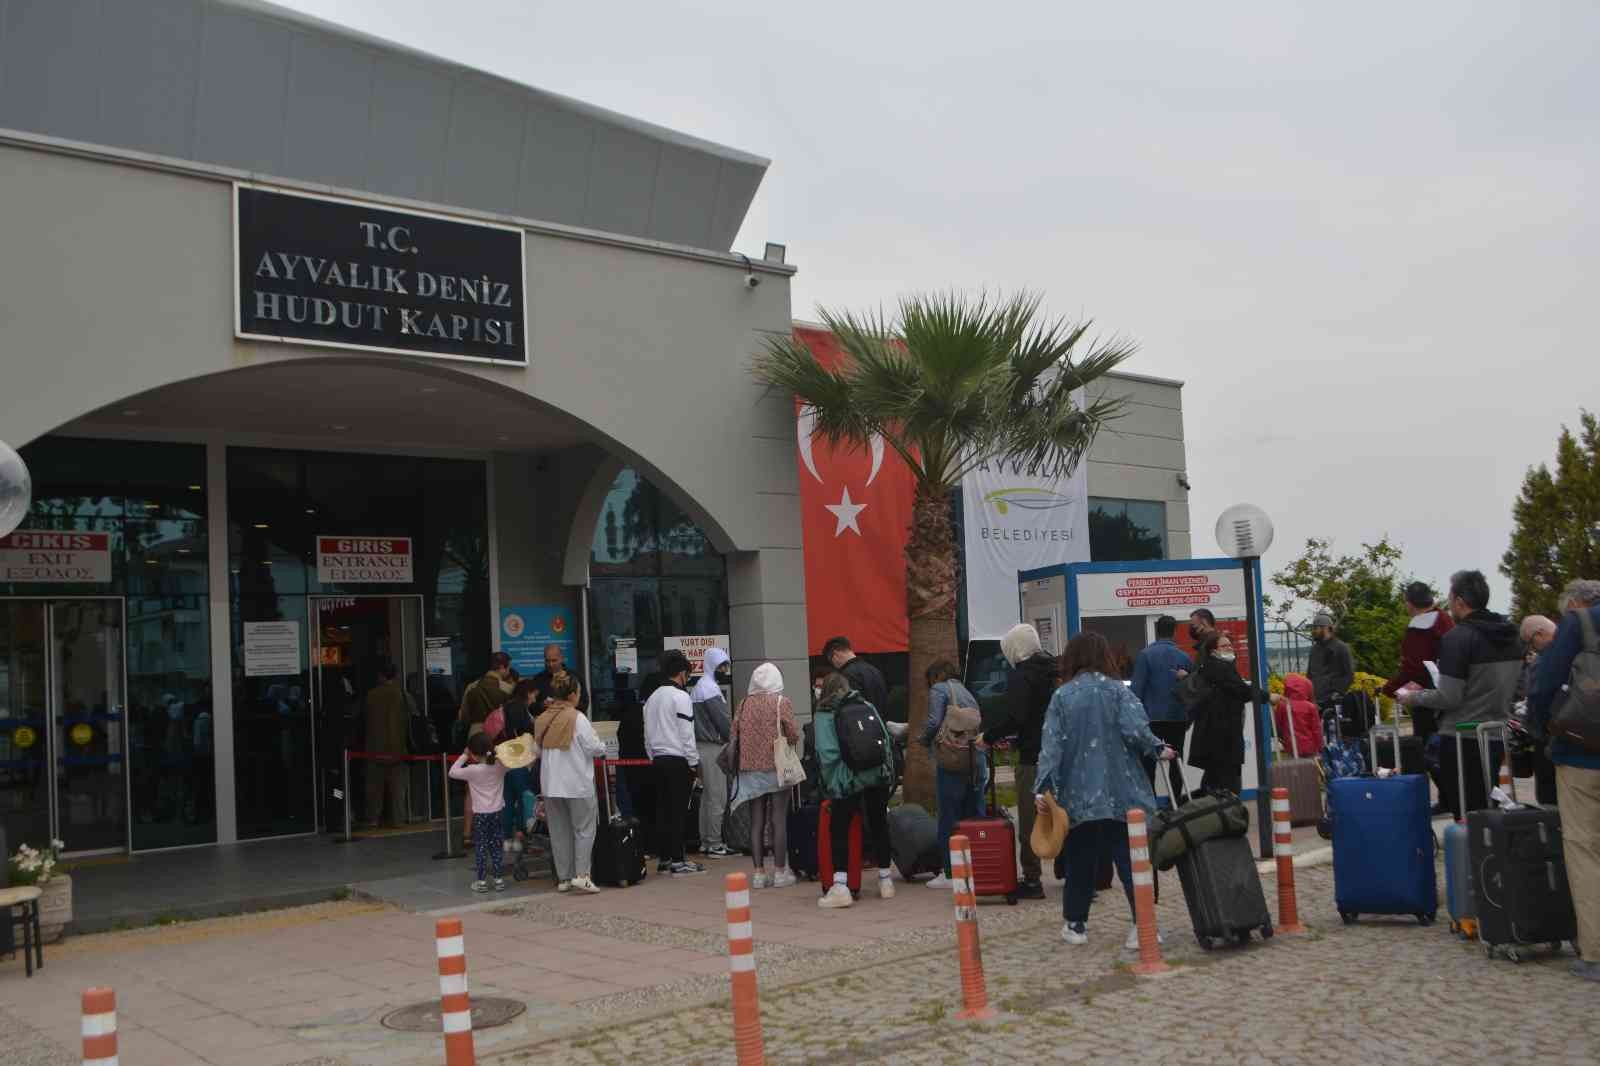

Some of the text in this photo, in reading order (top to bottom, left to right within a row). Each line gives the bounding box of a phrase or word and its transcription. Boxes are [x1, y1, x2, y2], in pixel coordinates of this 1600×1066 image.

[359, 221, 419, 254] T.C.
[255, 251, 512, 307] AYVALIK DENİZ
[254, 291, 513, 346] HUDUT KAPISI
[29, 553, 77, 565] EXIT
[322, 555, 409, 569] ENTRANCE
